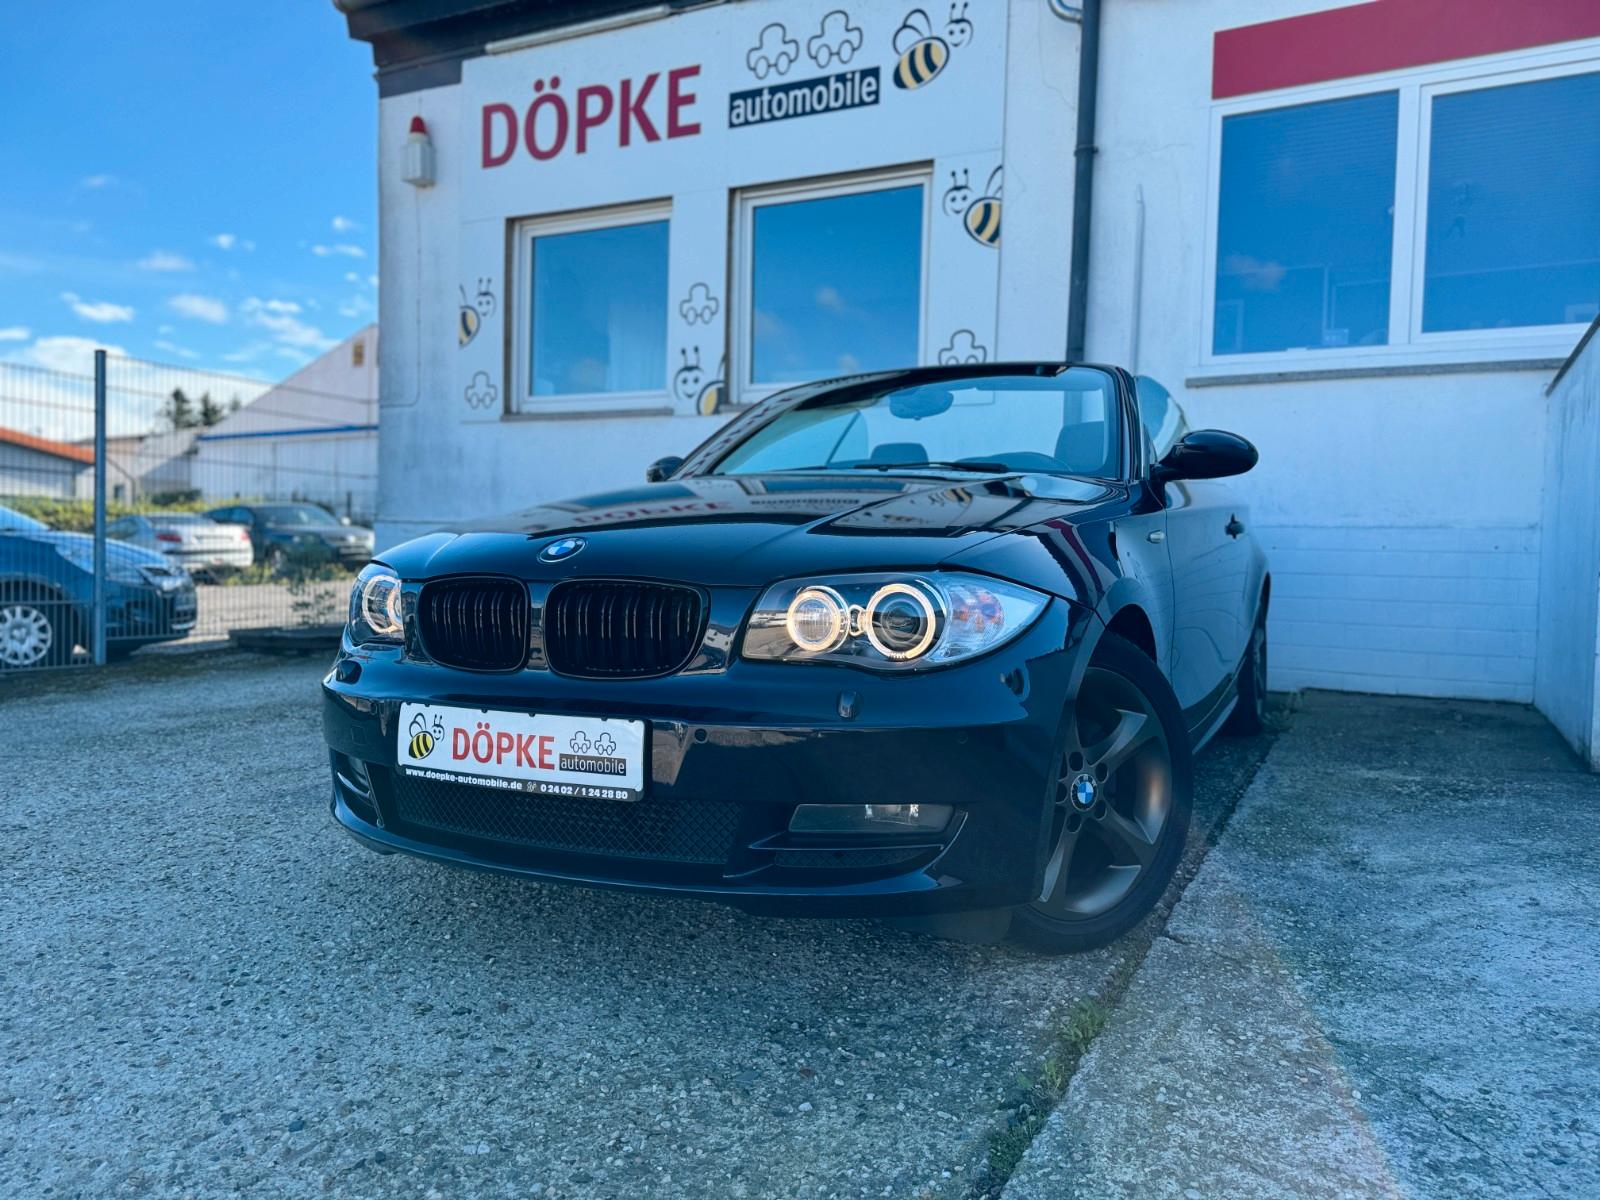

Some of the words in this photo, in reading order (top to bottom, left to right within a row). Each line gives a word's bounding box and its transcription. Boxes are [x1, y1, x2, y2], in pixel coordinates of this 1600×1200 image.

[482, 64, 702, 169] DÖPKE
[730, 71, 879, 125] automobile
[452, 721, 555, 770] DÖPKE
[560, 756, 625, 774] automobile
[405, 768, 523, 790] www.doepke-automobile.de
